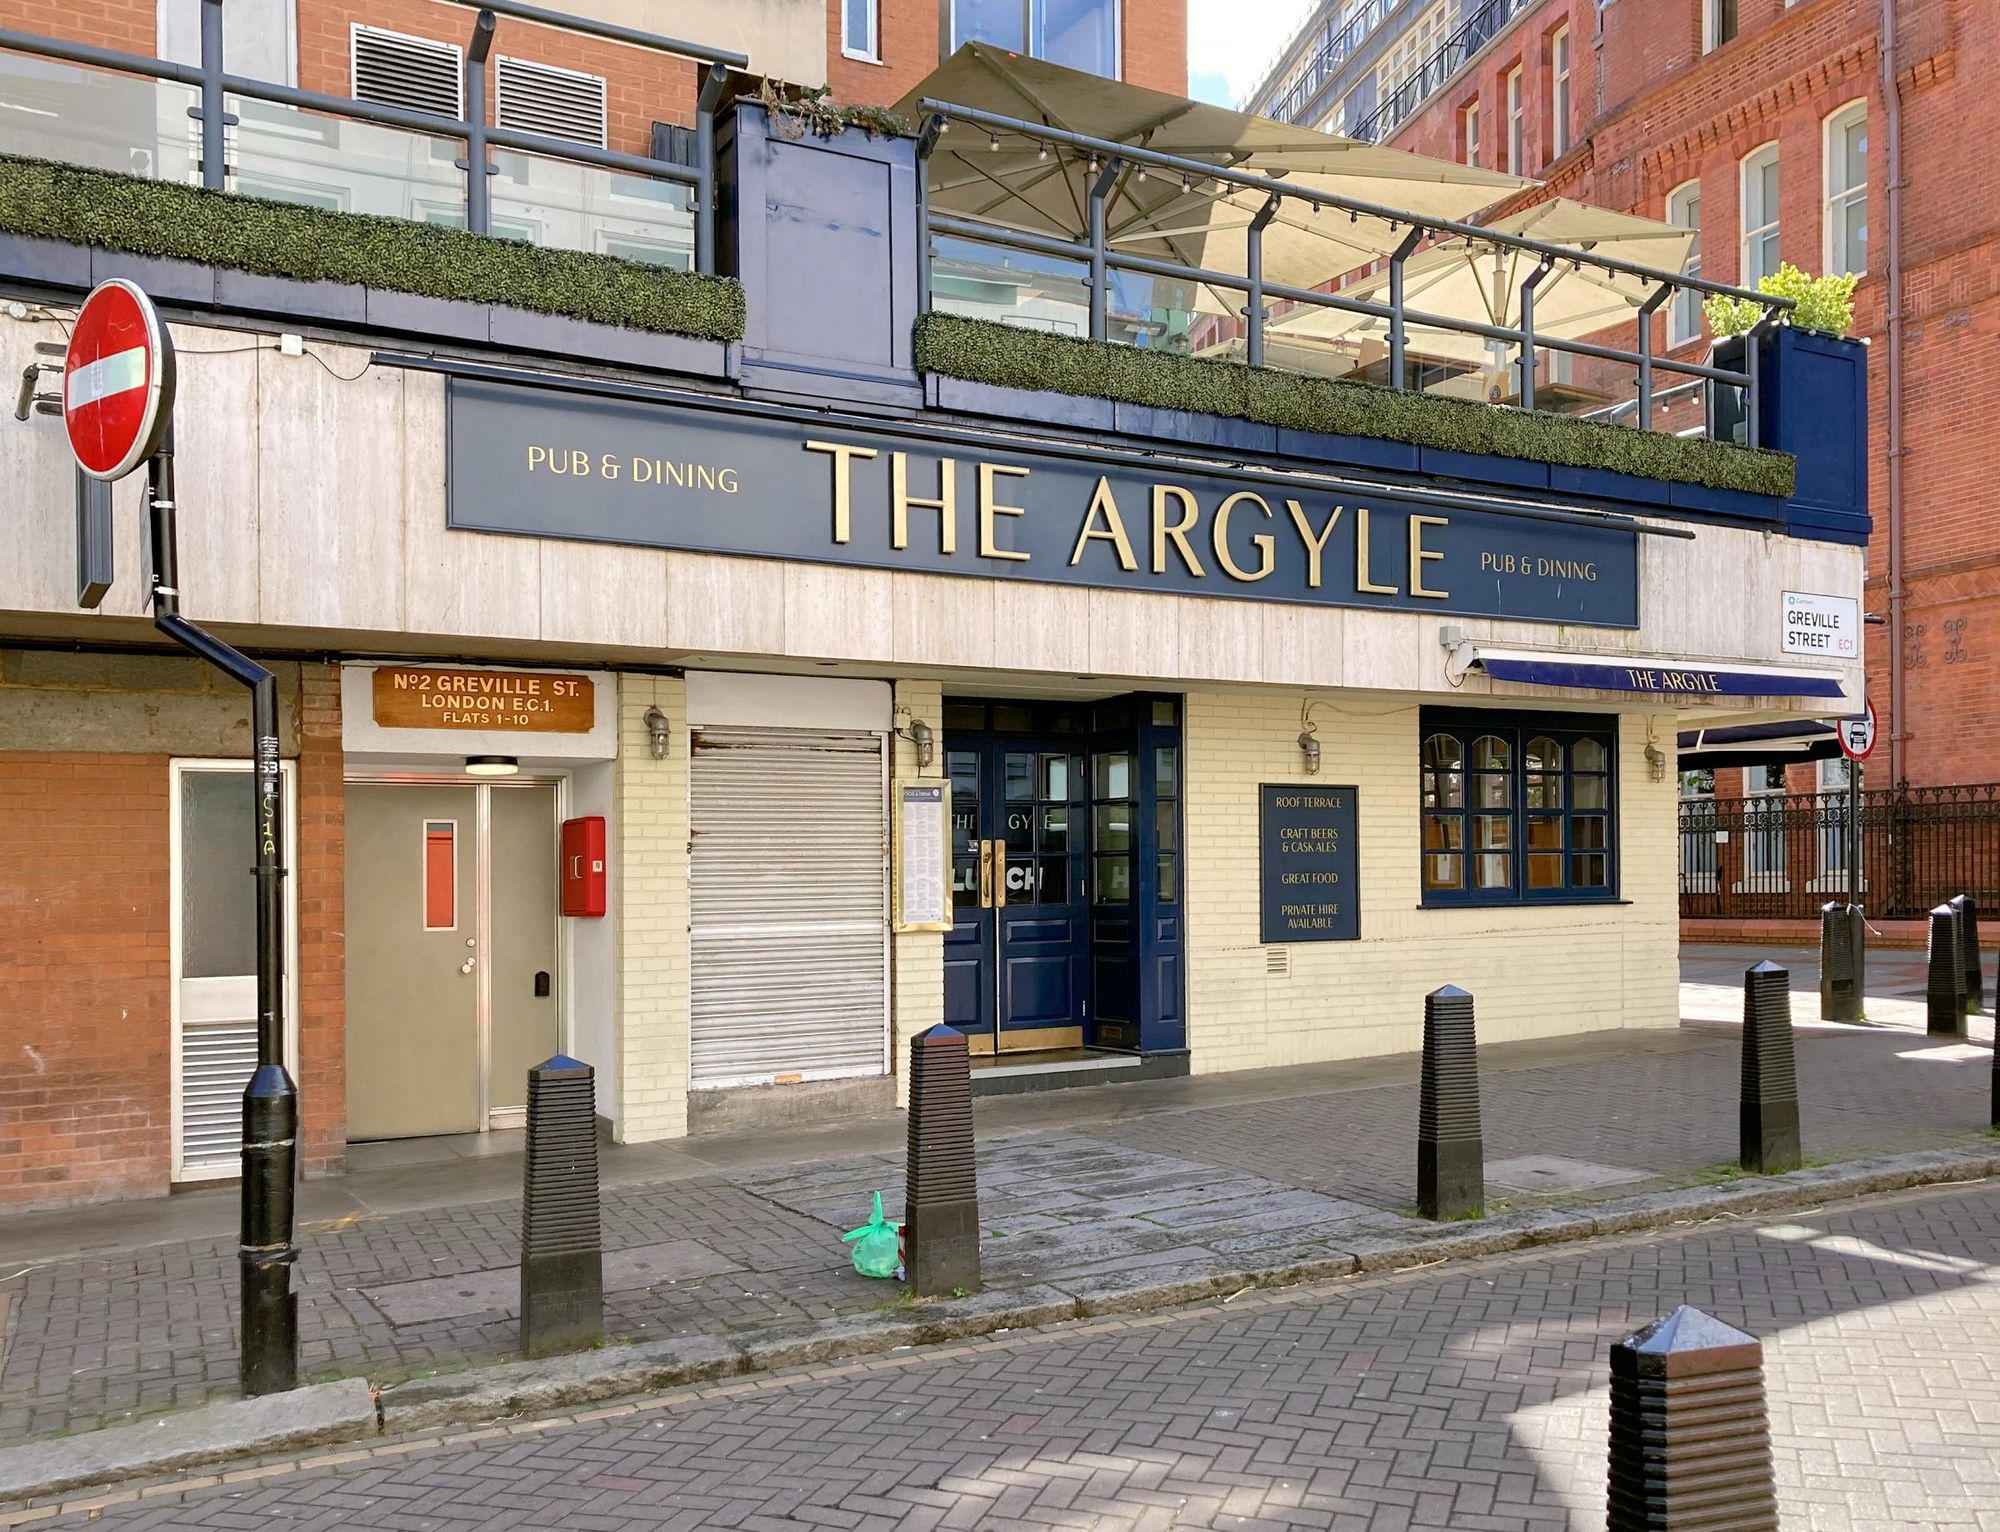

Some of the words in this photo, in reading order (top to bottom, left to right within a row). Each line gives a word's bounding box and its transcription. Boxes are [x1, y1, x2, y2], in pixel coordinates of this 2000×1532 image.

[527, 446, 590, 476] PUB
[601, 454, 621, 480] &
[632, 457, 739, 493] DINING
[807, 440, 1030, 561] THE
[1069, 475, 1449, 599] ARGYLE
[1481, 552, 1515, 574] PUB
[1521, 556, 1532, 576] &
[1538, 558, 1597, 582] DINING
[1788, 610, 1839, 628] GREVILLE
[1788, 631, 1830, 648] STREET
[1838, 639, 1853, 650] EC1
[436, 675, 540, 695] GREVILLE
[552, 680, 580, 697] ST.
[1626, 669, 1660, 690] THE
[1662, 672, 1722, 692] ARGYLE
[421, 694, 505, 710] LONDON
[443, 711, 490, 724] FLATS
[496, 714, 529, 725] 1-10
[1276, 797, 1301, 808] ROOF
[1303, 797, 1342, 808] TERRACE
[1280, 828, 1309, 839] CRAFT
[1311, 829, 1339, 839] BEERS
[1282, 842, 1289, 853] &
[1291, 841, 1315, 853] CASK
[1316, 842, 1337, 853] ALES
[1281, 873, 1310, 884] GREAT
[1312, 873, 1338, 884] FOOD
[1281, 904, 1316, 916] PRIVATE
[1318, 904, 1339, 915] HIRE
[1287, 917, 1333, 929] AVAILABLE
